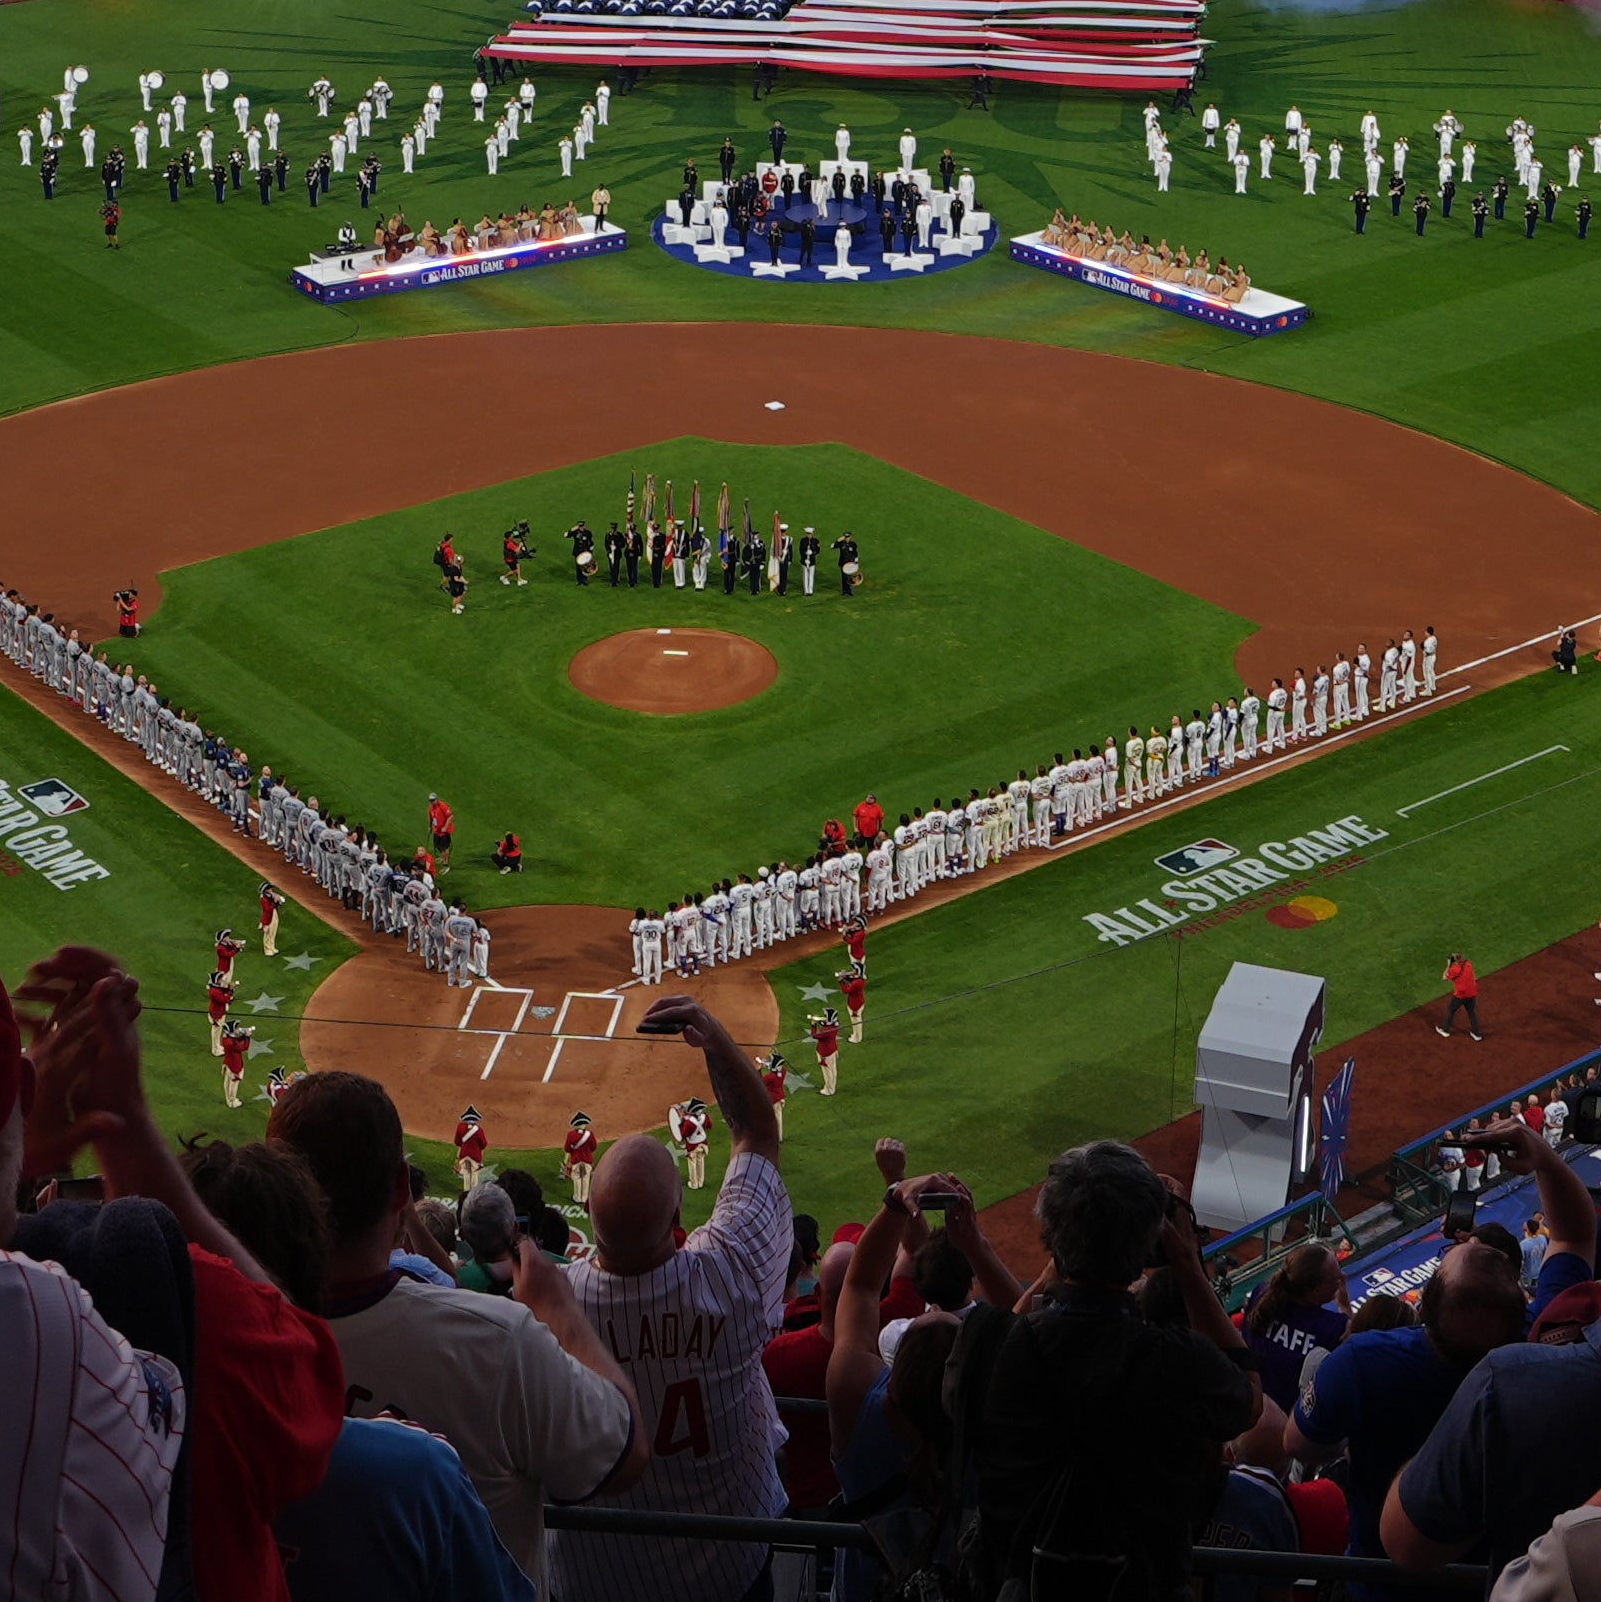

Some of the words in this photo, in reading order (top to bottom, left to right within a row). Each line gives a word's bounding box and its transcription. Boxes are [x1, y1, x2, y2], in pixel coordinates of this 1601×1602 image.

[441, 266, 459, 281] ALL
[458, 262, 481, 278] STAR
[481, 259, 505, 274] GAME
[1097, 272, 1112, 289] ALL
[1111, 277, 1131, 294] STAR
[1130, 283, 1151, 300] GAME
[5, 825, 111, 891] GAME
[1082, 898, 1191, 947] ALL
[1161, 858, 1290, 912] STAR
[1258, 814, 1390, 871] GAME
[1170, 877, 1311, 940] PHILADELPHIA
[1366, 1275, 1411, 1297] STAR
[1400, 1256, 1442, 1286] GAME
[606, 1312, 727, 1364] LADAY
[1265, 1321, 1316, 1356] TAFF
